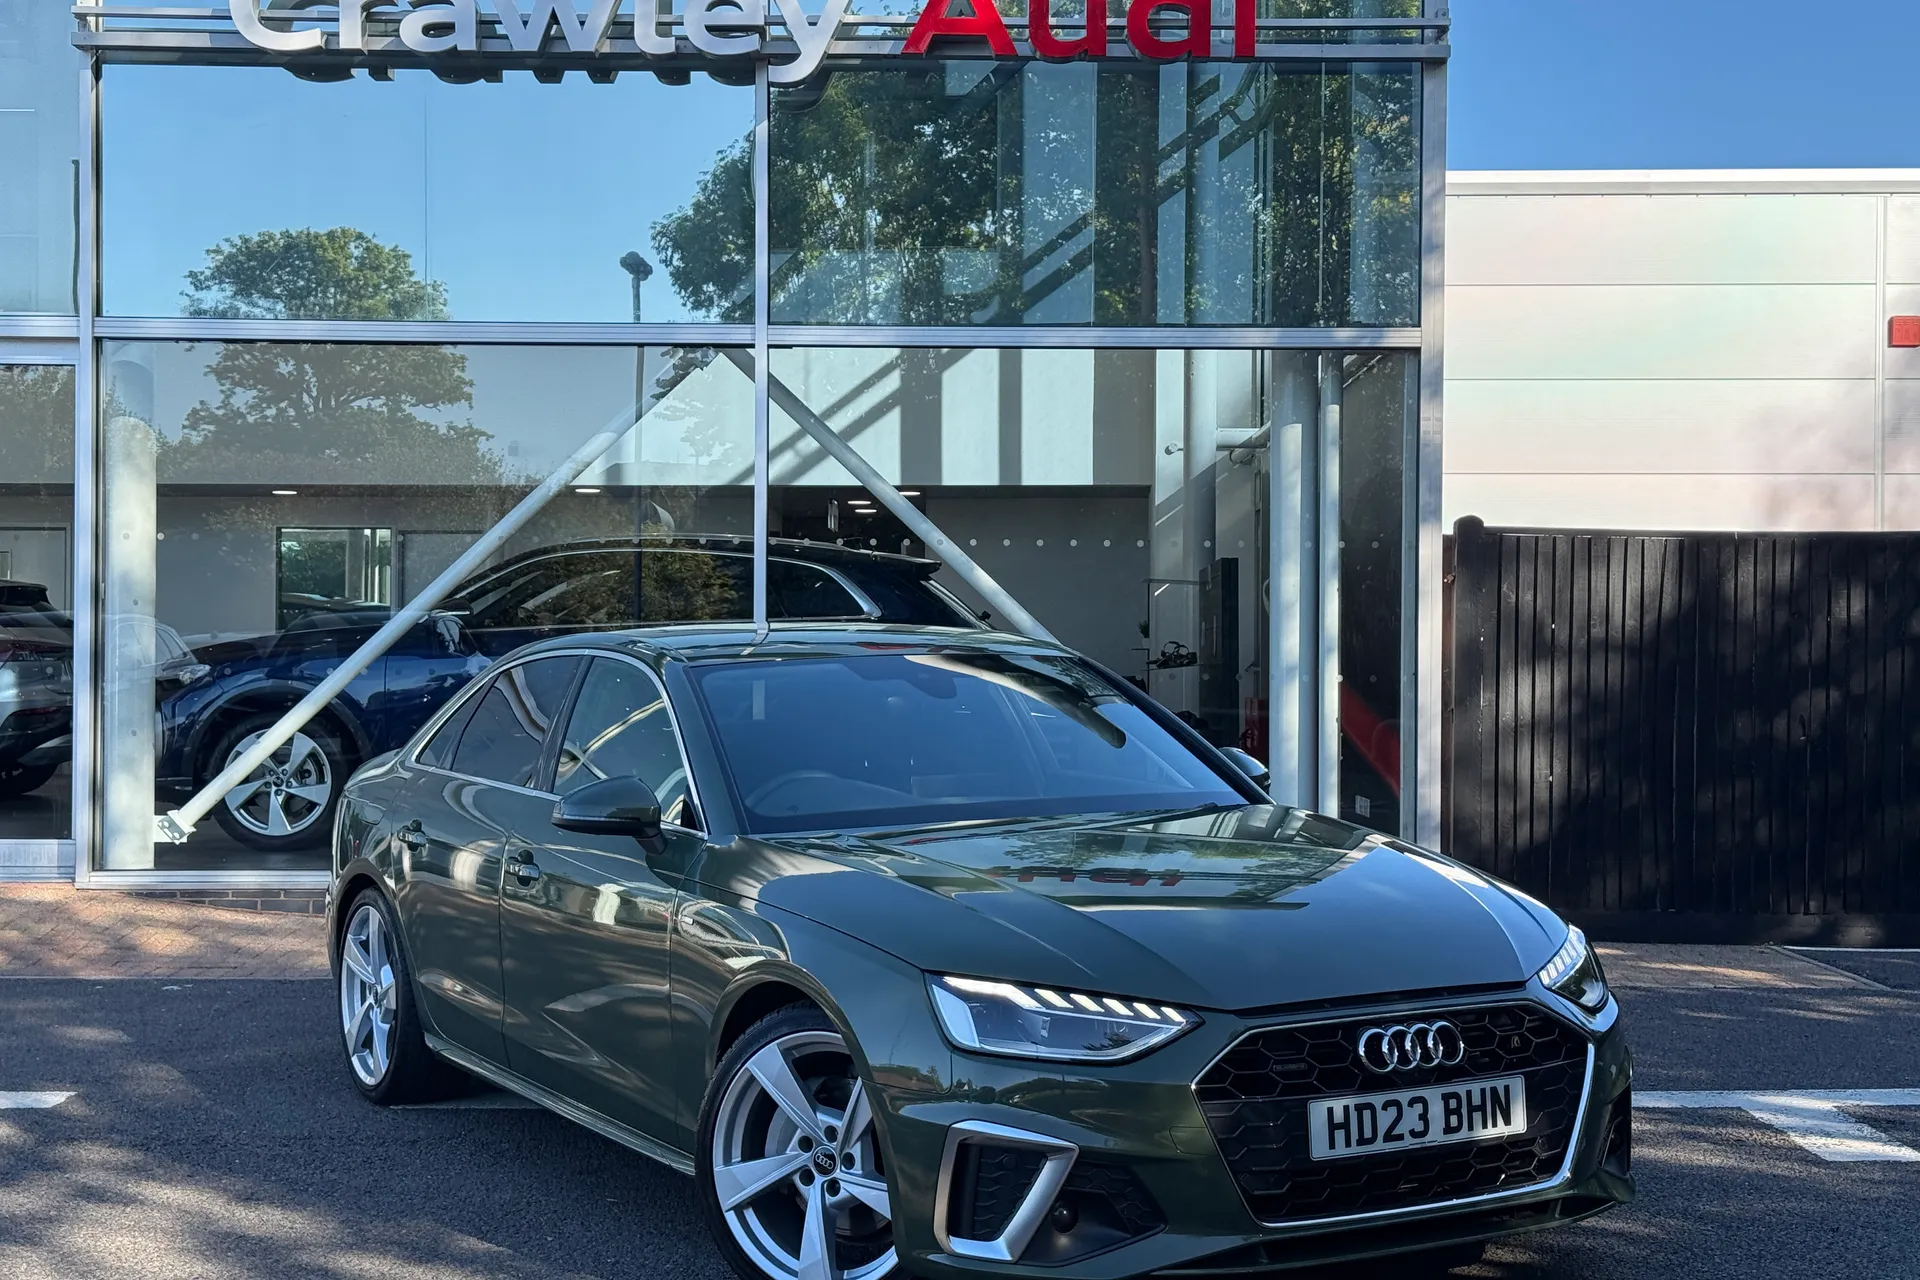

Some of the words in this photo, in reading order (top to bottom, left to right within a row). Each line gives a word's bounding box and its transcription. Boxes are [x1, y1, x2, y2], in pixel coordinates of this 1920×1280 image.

[230, 0, 853, 83] Crawley
[1327, 1096, 1430, 1150] HD23
[1441, 1084, 1512, 1135] BHN
